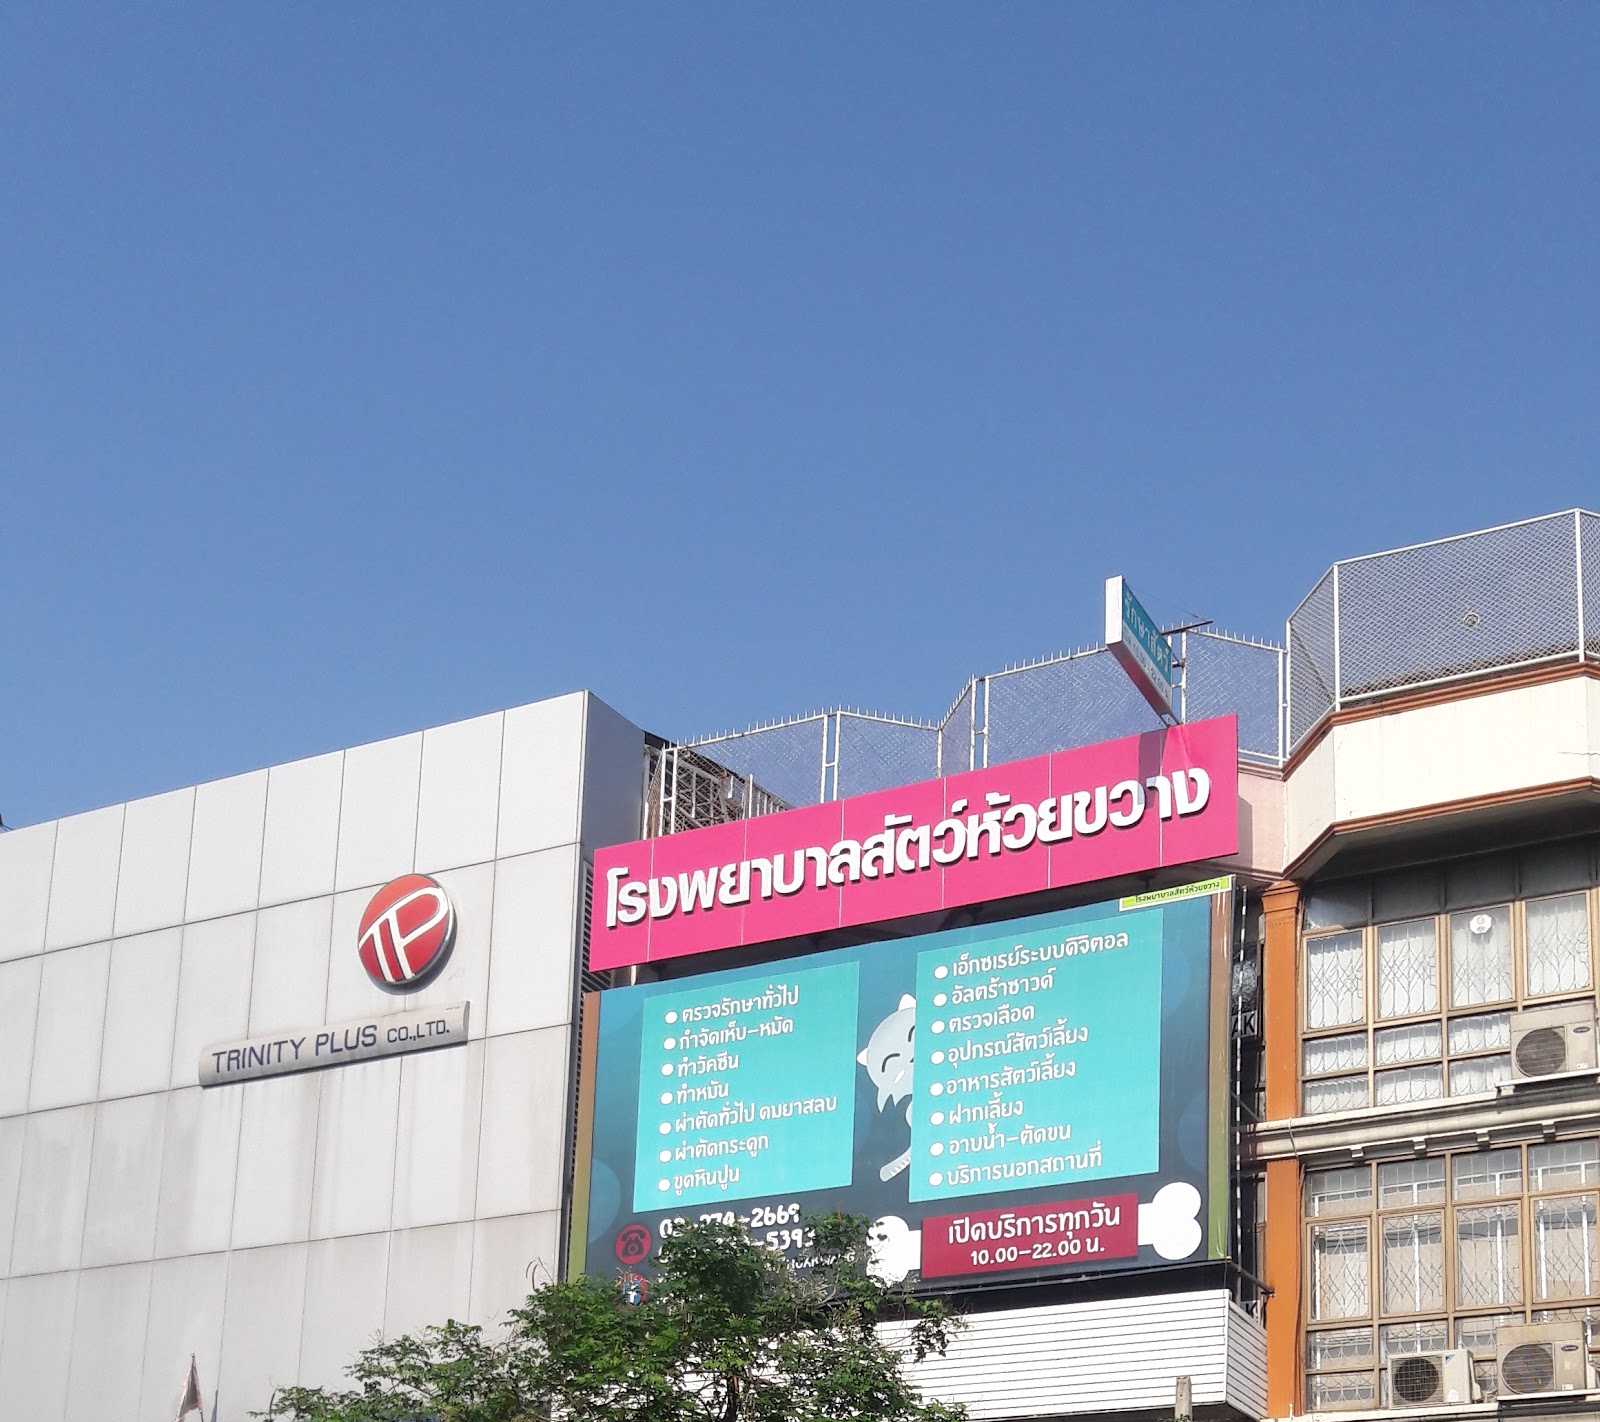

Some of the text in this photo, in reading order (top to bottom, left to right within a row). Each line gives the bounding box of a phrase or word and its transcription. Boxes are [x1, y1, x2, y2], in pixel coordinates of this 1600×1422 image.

[605, 766, 1213, 927] โรงพยาบาลสัตว์ห้วยขวาง
[951, 931, 1129, 978] เอ็กซเรย์ระบบดิจิตอล
[682, 984, 800, 1023] ตรวจรักษาทั่วไป
[951, 967, 1057, 1005] อัลตร้าซาวด์
[949, 1003, 1035, 1033] ตรวจเลือด
[212, 1020, 450, 1074] TRINITY PLUS CO.,LTD.
[947, 1018, 1089, 1069] อุปกรณ์สัตว์เลี้ยง
[676, 1051, 740, 1078] ทำวัคซีน
[946, 1053, 1076, 1095] อาหารสัตว์เลี้ยง
[676, 1079, 730, 1104] ทำหมัน
[948, 1091, 1024, 1126] ฝากเลี้ยง
[675, 1100, 755, 1133] ผ่าตัดทั่วไป
[675, 1134, 769, 1162] ผ่าตัดกระดูก
[946, 1140, 1102, 1186] บริการนอกสถานที่
[673, 1165, 740, 1196] ขูดหินปูน
[948, 1201, 1120, 1244] เปิดบริการทุกวัน
[1086, 1237, 1105, 1253] น.
